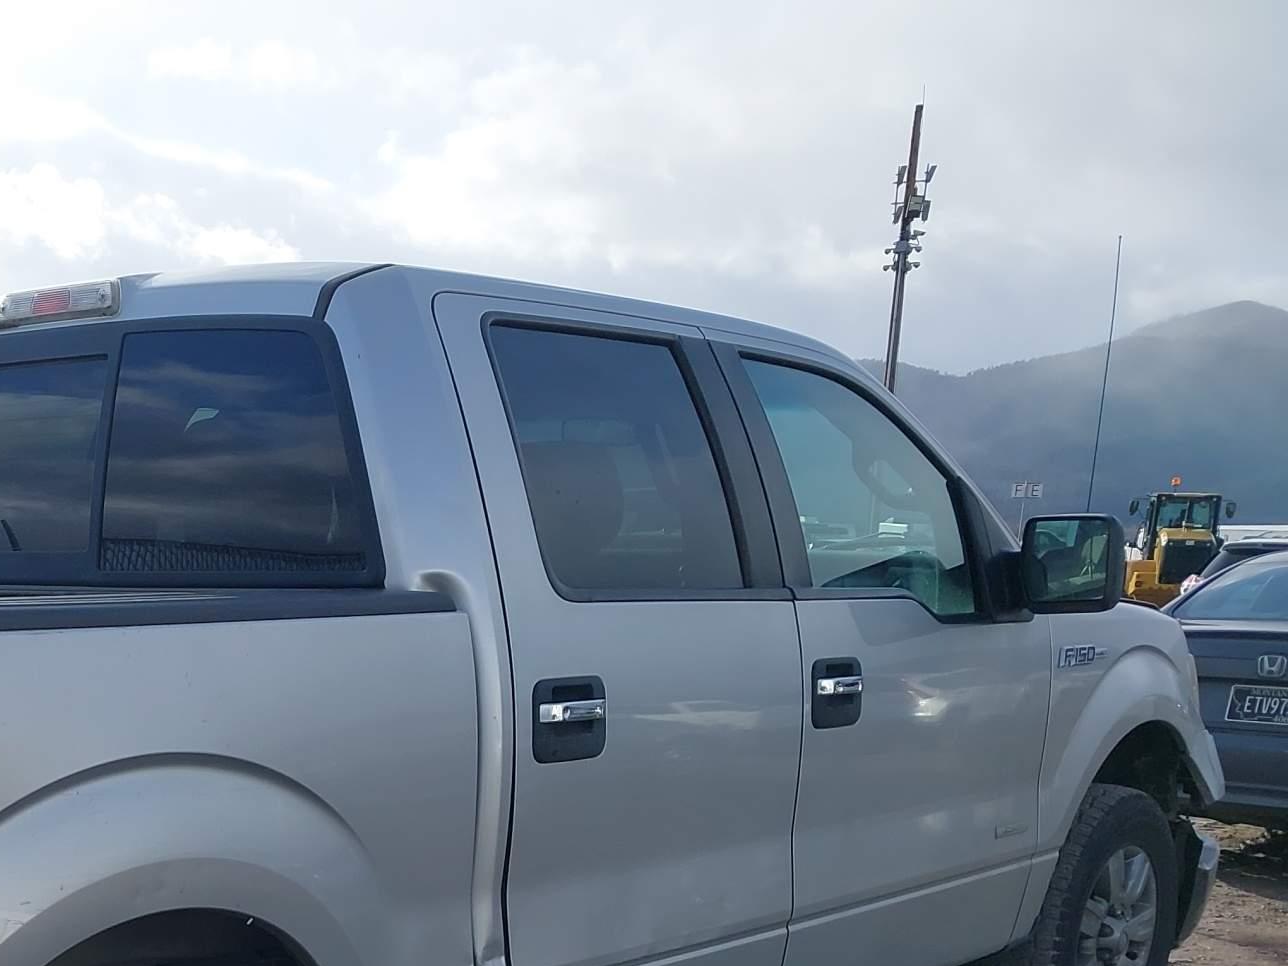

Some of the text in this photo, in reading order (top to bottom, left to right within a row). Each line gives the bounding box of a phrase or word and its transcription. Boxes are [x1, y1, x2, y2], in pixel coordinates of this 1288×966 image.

[1014, 484, 1041, 497] F E
[1243, 696, 1288, 714] ETV97
